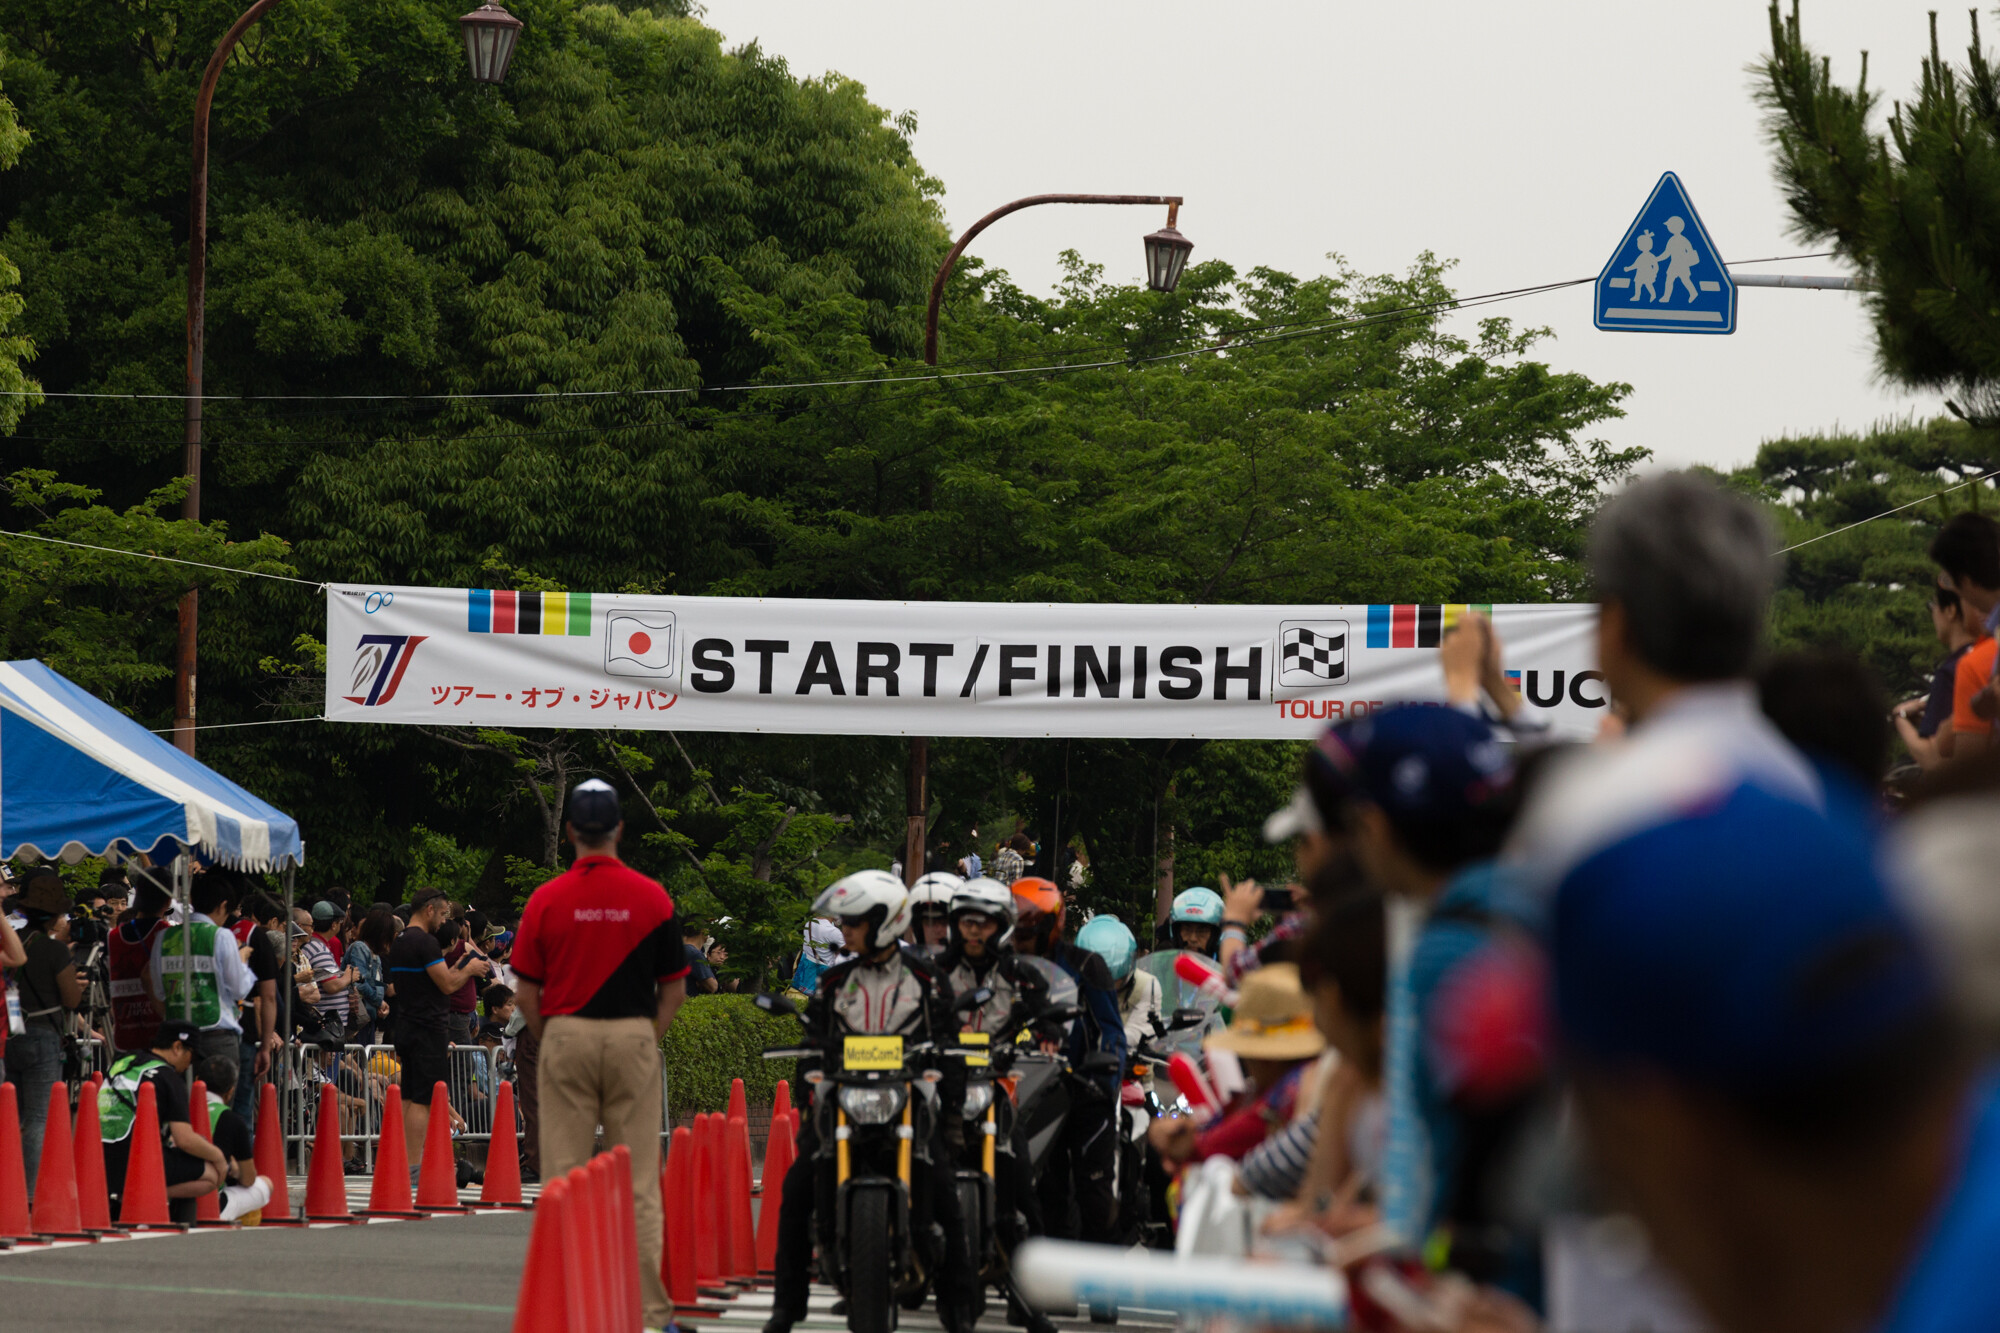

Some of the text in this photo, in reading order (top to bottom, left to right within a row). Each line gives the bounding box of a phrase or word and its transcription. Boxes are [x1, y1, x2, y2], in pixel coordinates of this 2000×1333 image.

[690, 637, 1263, 701] START/FINISH
[430, 685, 679, 711] ツアー・オブ・ジャパン
[1275, 699, 1345, 719] TOUR
[605, 909, 630, 921] TOUR
